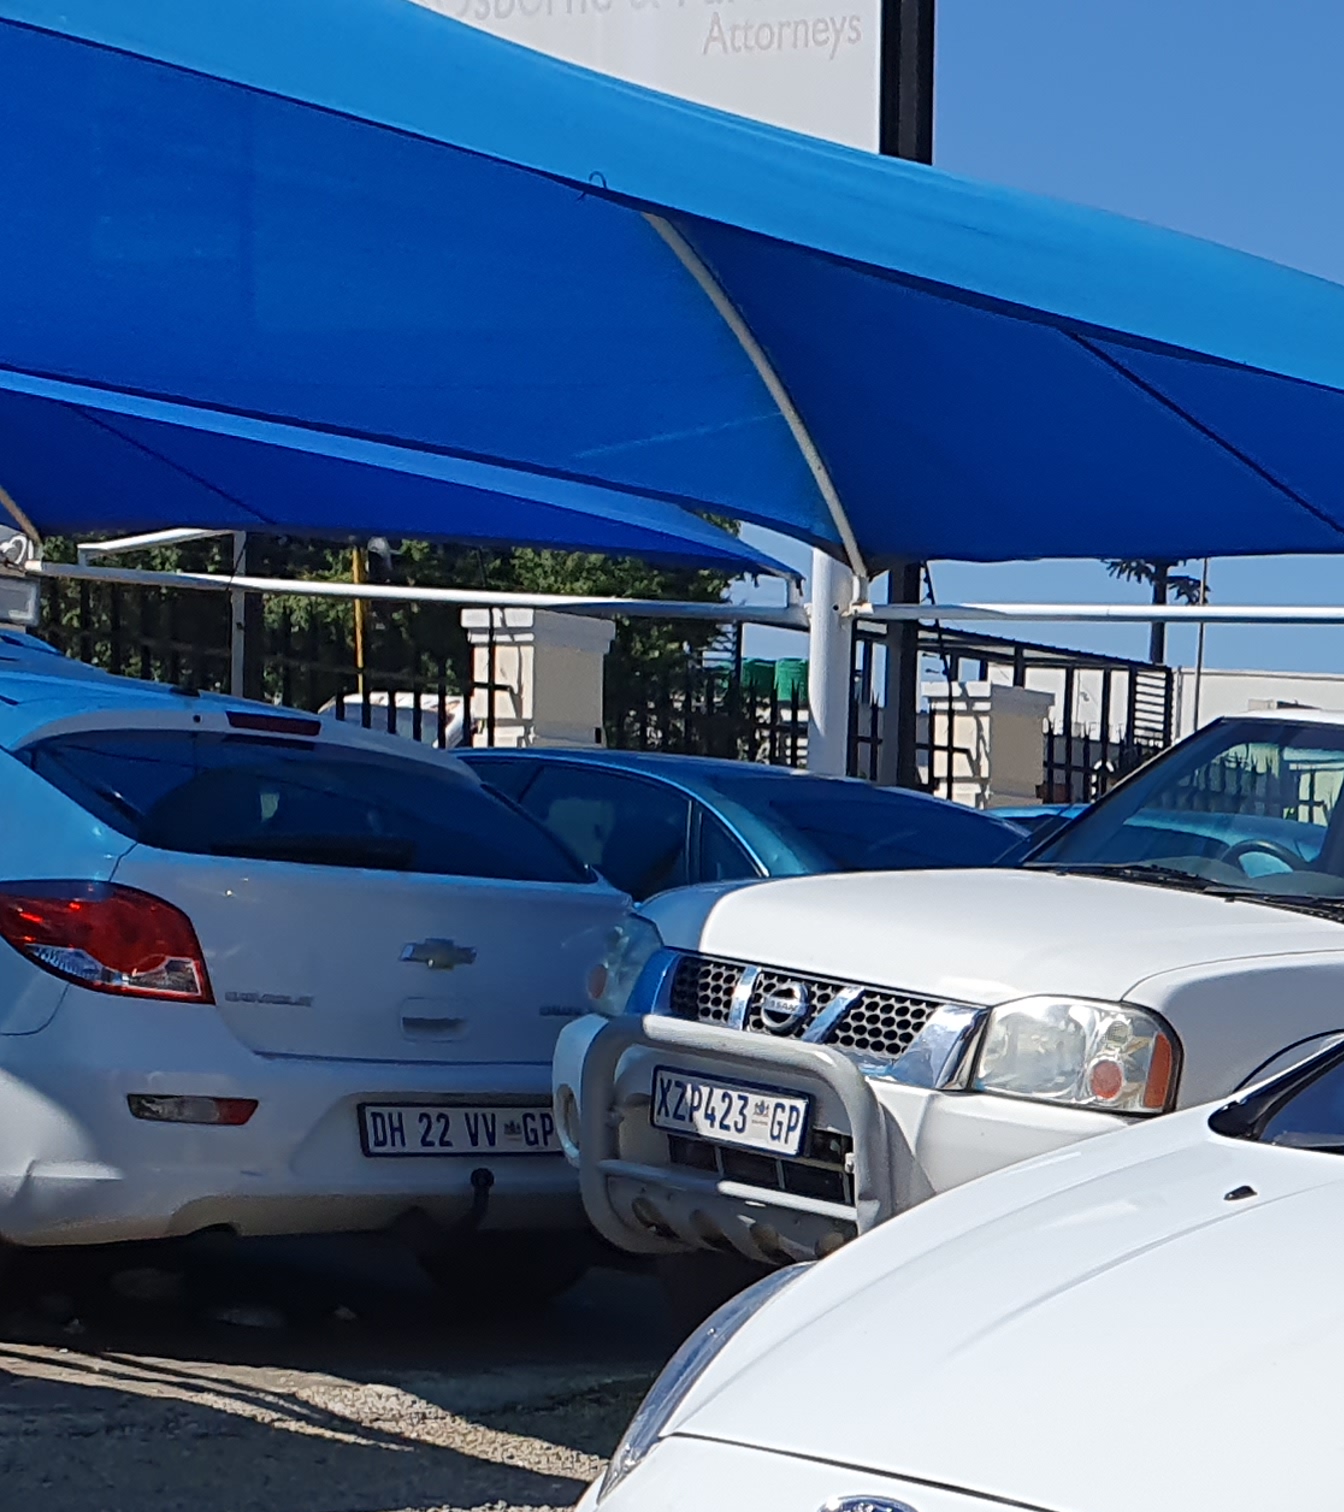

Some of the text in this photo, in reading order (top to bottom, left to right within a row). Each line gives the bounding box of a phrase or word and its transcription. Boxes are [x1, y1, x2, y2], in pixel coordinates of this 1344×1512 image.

[703, 11, 862, 60] Attorneys
[372, 1110, 555, 1149] DH 22 VV GP
[656, 1077, 800, 1145] XZP423 GP
